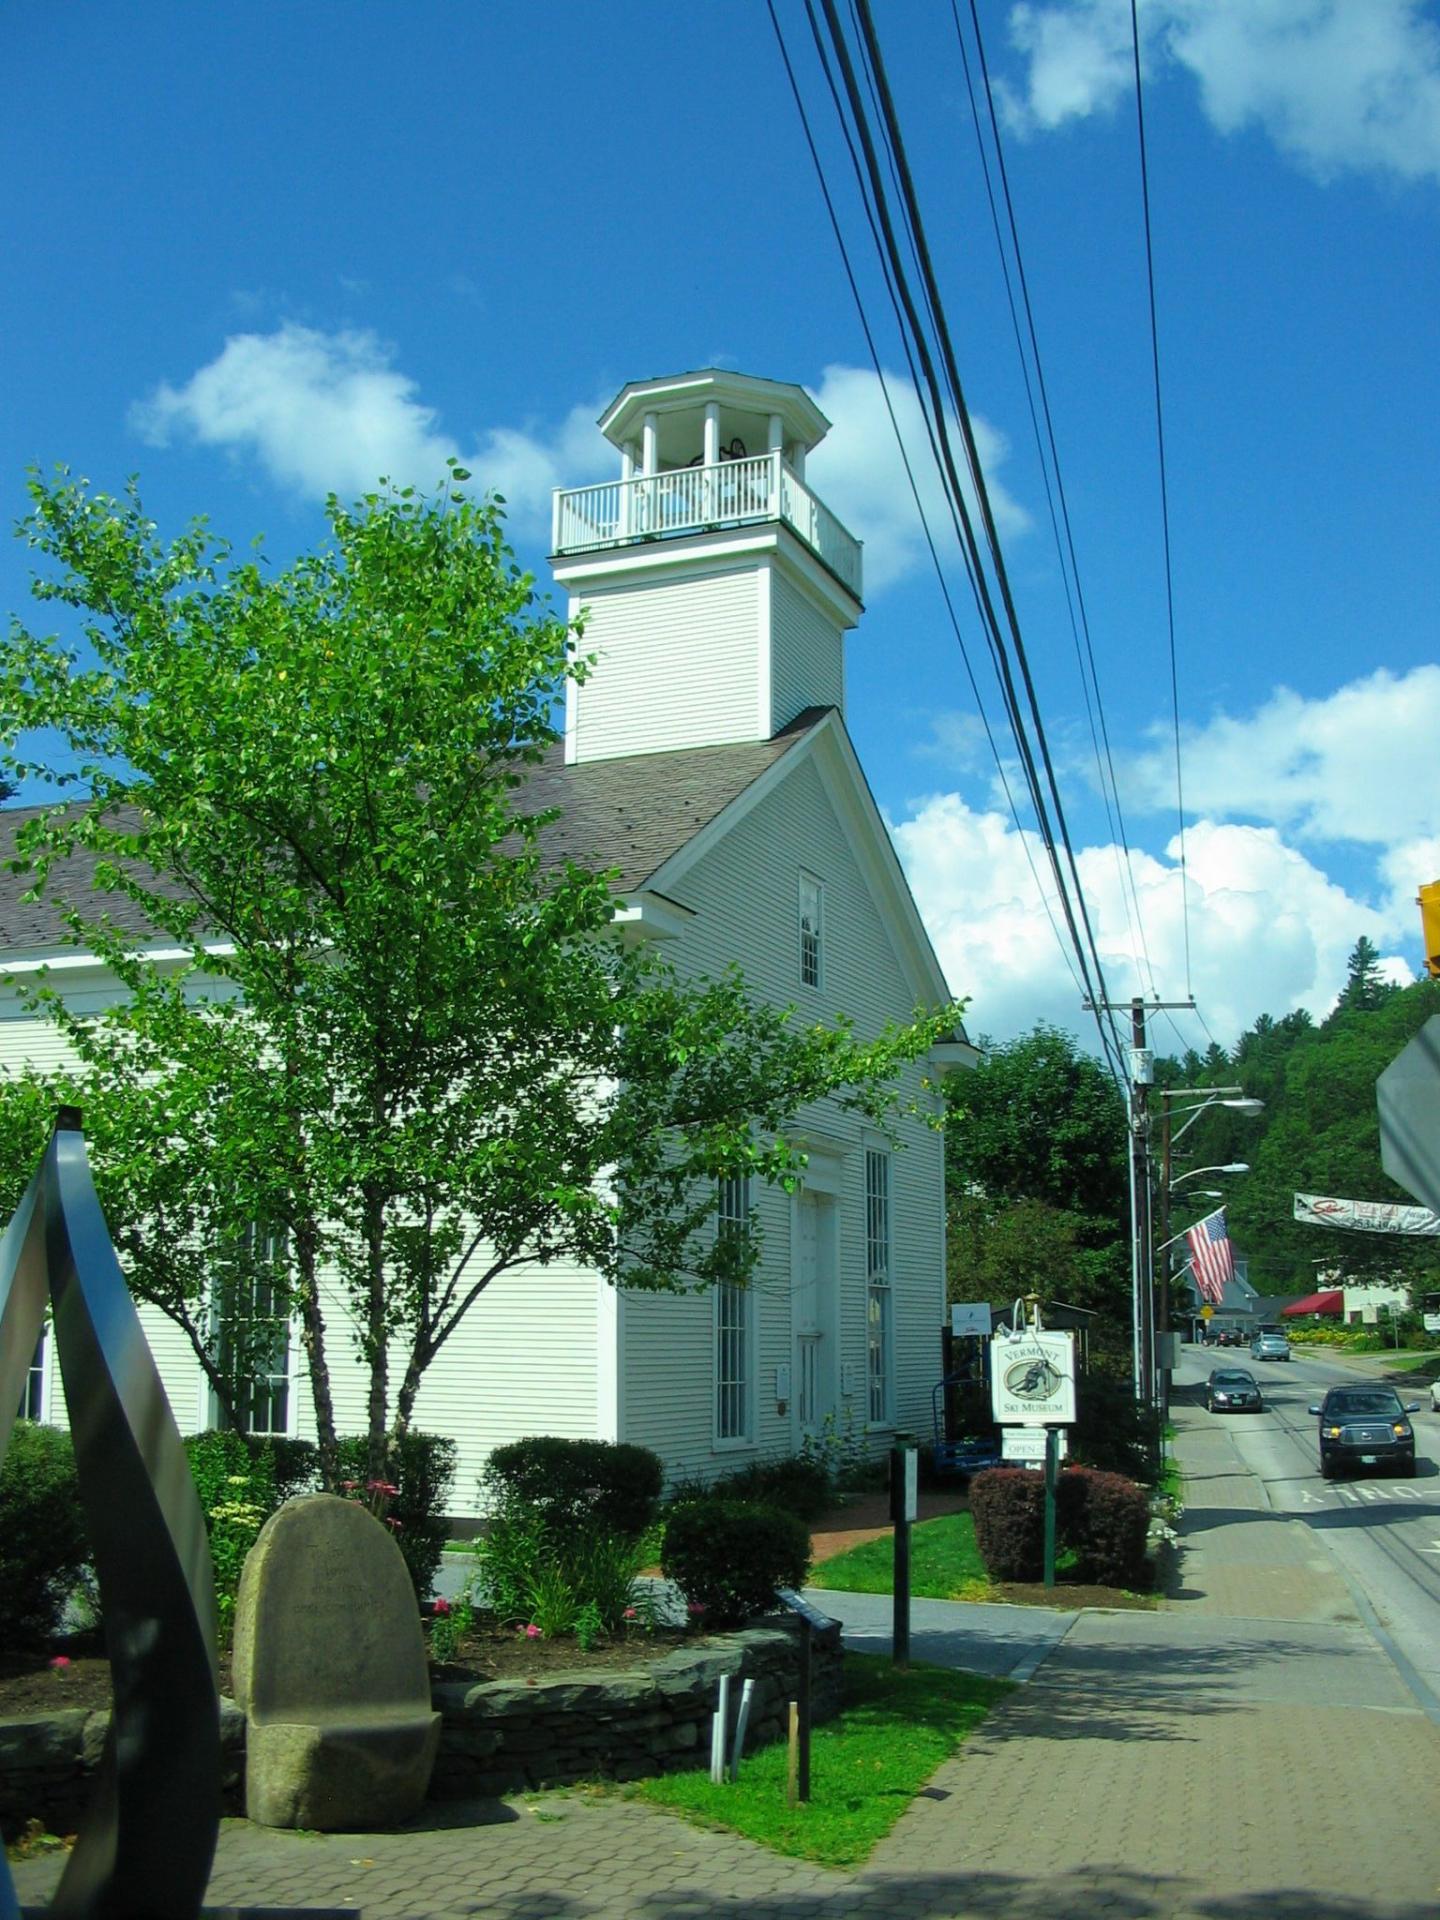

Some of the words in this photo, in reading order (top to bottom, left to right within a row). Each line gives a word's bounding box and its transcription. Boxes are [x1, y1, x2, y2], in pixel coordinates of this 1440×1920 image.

[1005, 1347, 1059, 1361] VERMONT
[1004, 1403, 1018, 1413] SKI
[1022, 1403, 1063, 1412] MUSEUM
[1009, 1444, 1035, 1453] OPEN
